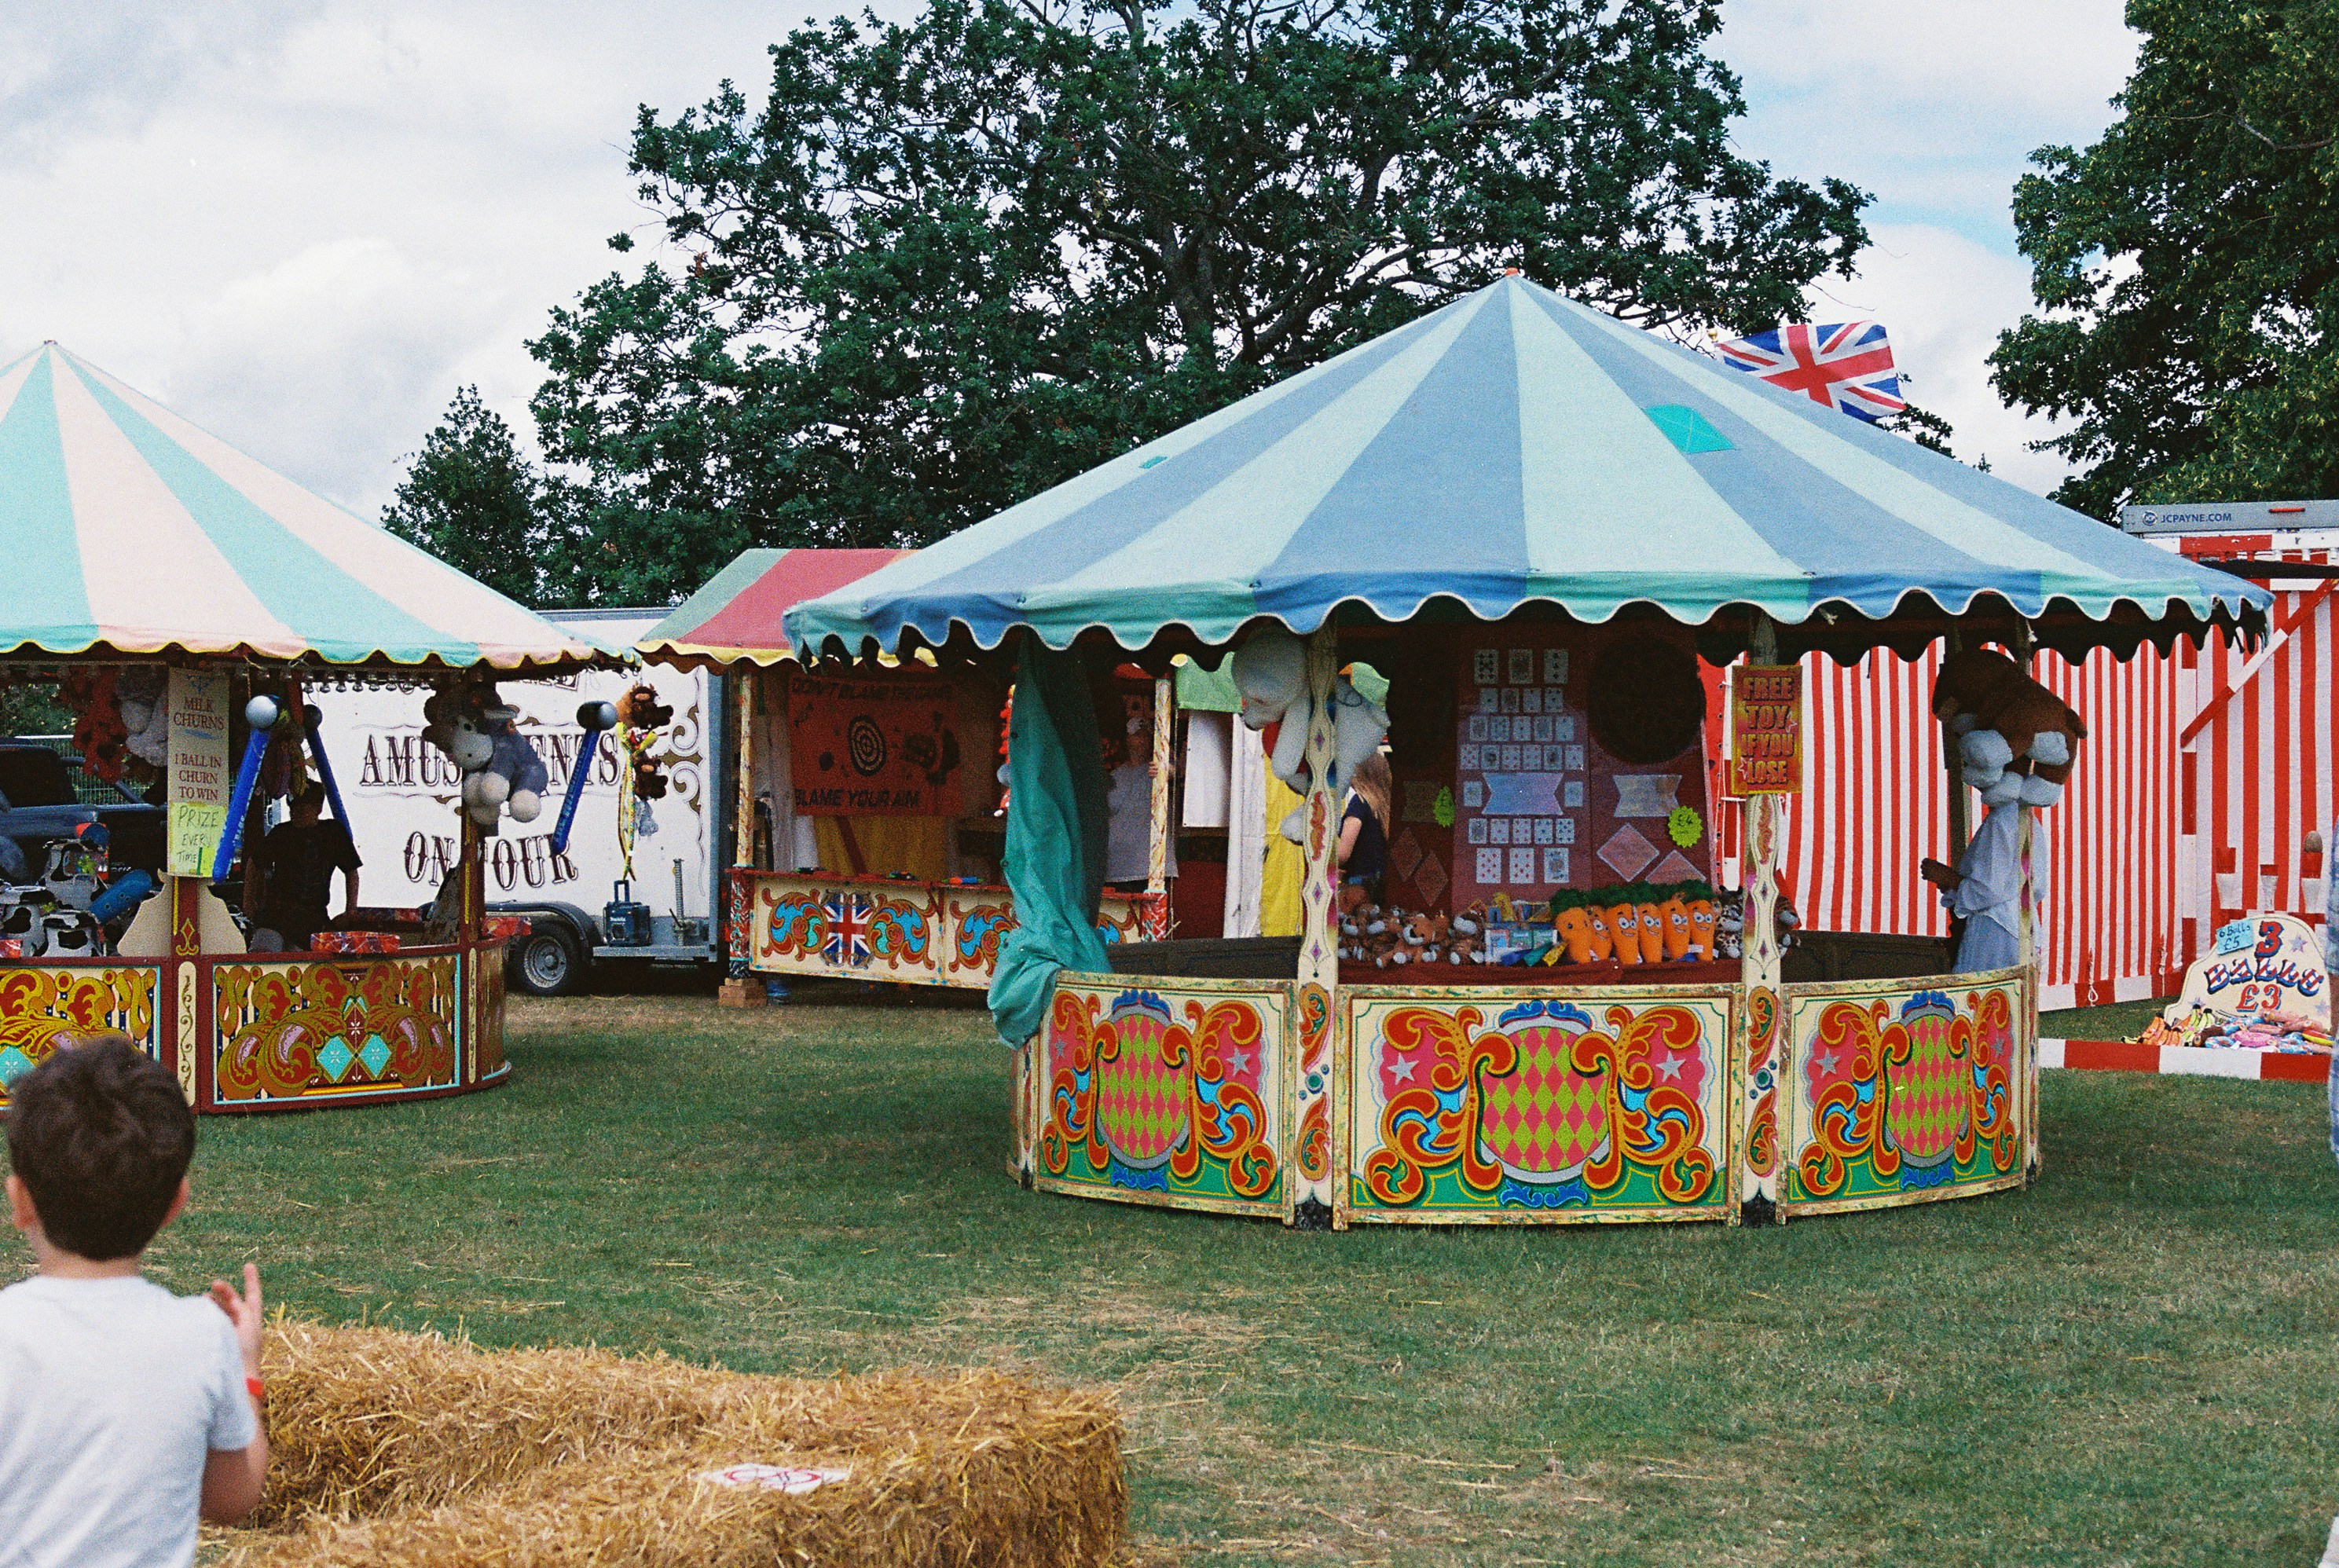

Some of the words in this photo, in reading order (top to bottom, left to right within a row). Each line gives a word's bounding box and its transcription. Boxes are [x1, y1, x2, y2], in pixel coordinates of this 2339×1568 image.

[2161, 513, 2232, 523] JCPAYNE.COM
[1743, 676, 1795, 701] FREE
[184, 697, 214, 712] MILK
[1746, 705, 1790, 730] TOY
[1741, 733, 1758, 758] IF
[1758, 733, 1795, 758] YOU
[174, 753, 179, 764] 1
[181, 753, 207, 768] BALL
[210, 757, 222, 768] IN
[178, 770, 218, 784] CHURN
[1747, 760, 1789, 784] LOSE
[179, 786, 195, 799] TO
[197, 788, 218, 800] WIN
[794, 788, 844, 807] BLAME
[848, 789, 890, 808] YOUR
[890, 789, 920, 808] AIM
[178, 804, 219, 828] PRIZE
[181, 833, 213, 848] EVERY
[403, 831, 455, 886] ON
[2224, 935, 2240, 951] £5
[2254, 921, 2285, 958] 3
[2235, 984, 2282, 1013] £3
